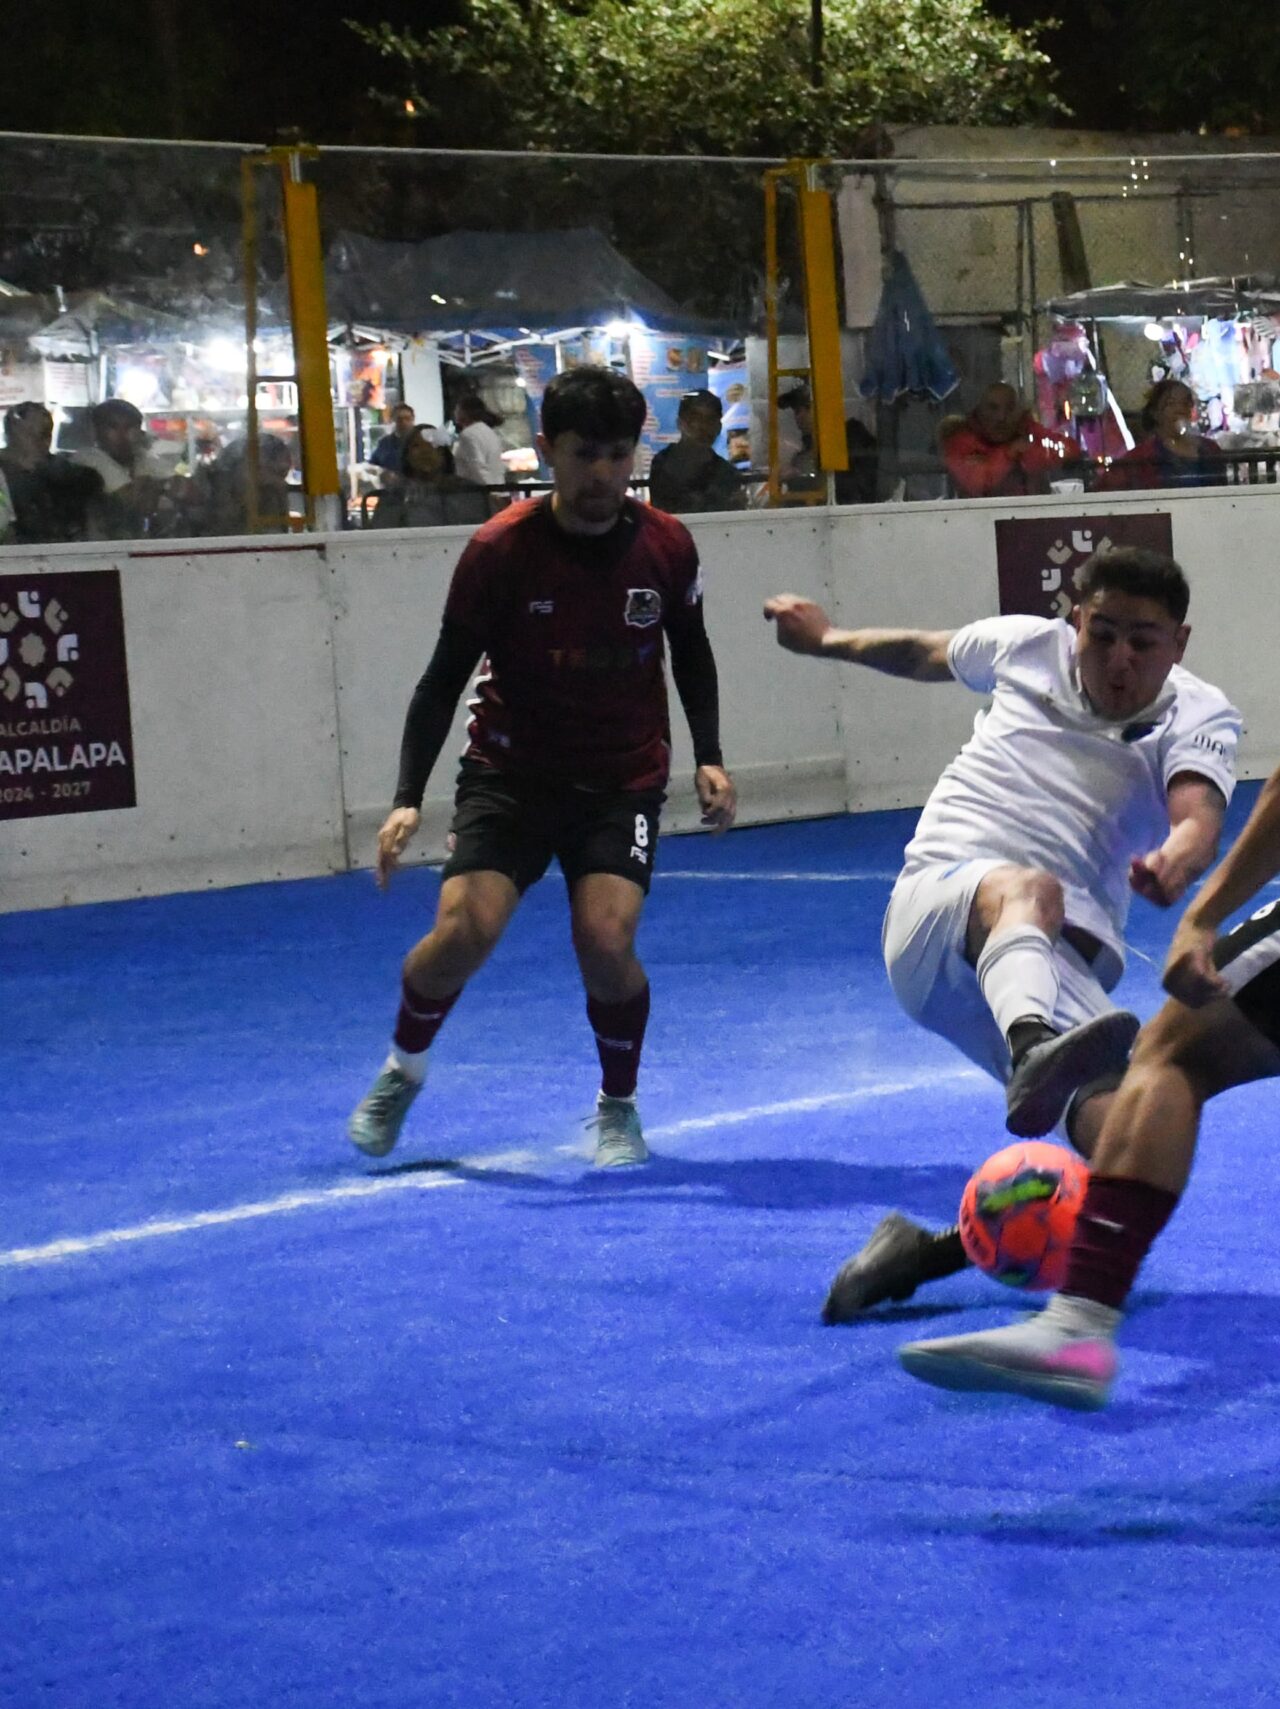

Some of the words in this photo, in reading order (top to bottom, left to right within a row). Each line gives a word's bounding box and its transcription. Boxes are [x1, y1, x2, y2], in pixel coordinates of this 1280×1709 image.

[0, 785, 35, 803] 024
[52, 781, 92, 799] 2027
[634, 812, 649, 848] 8
